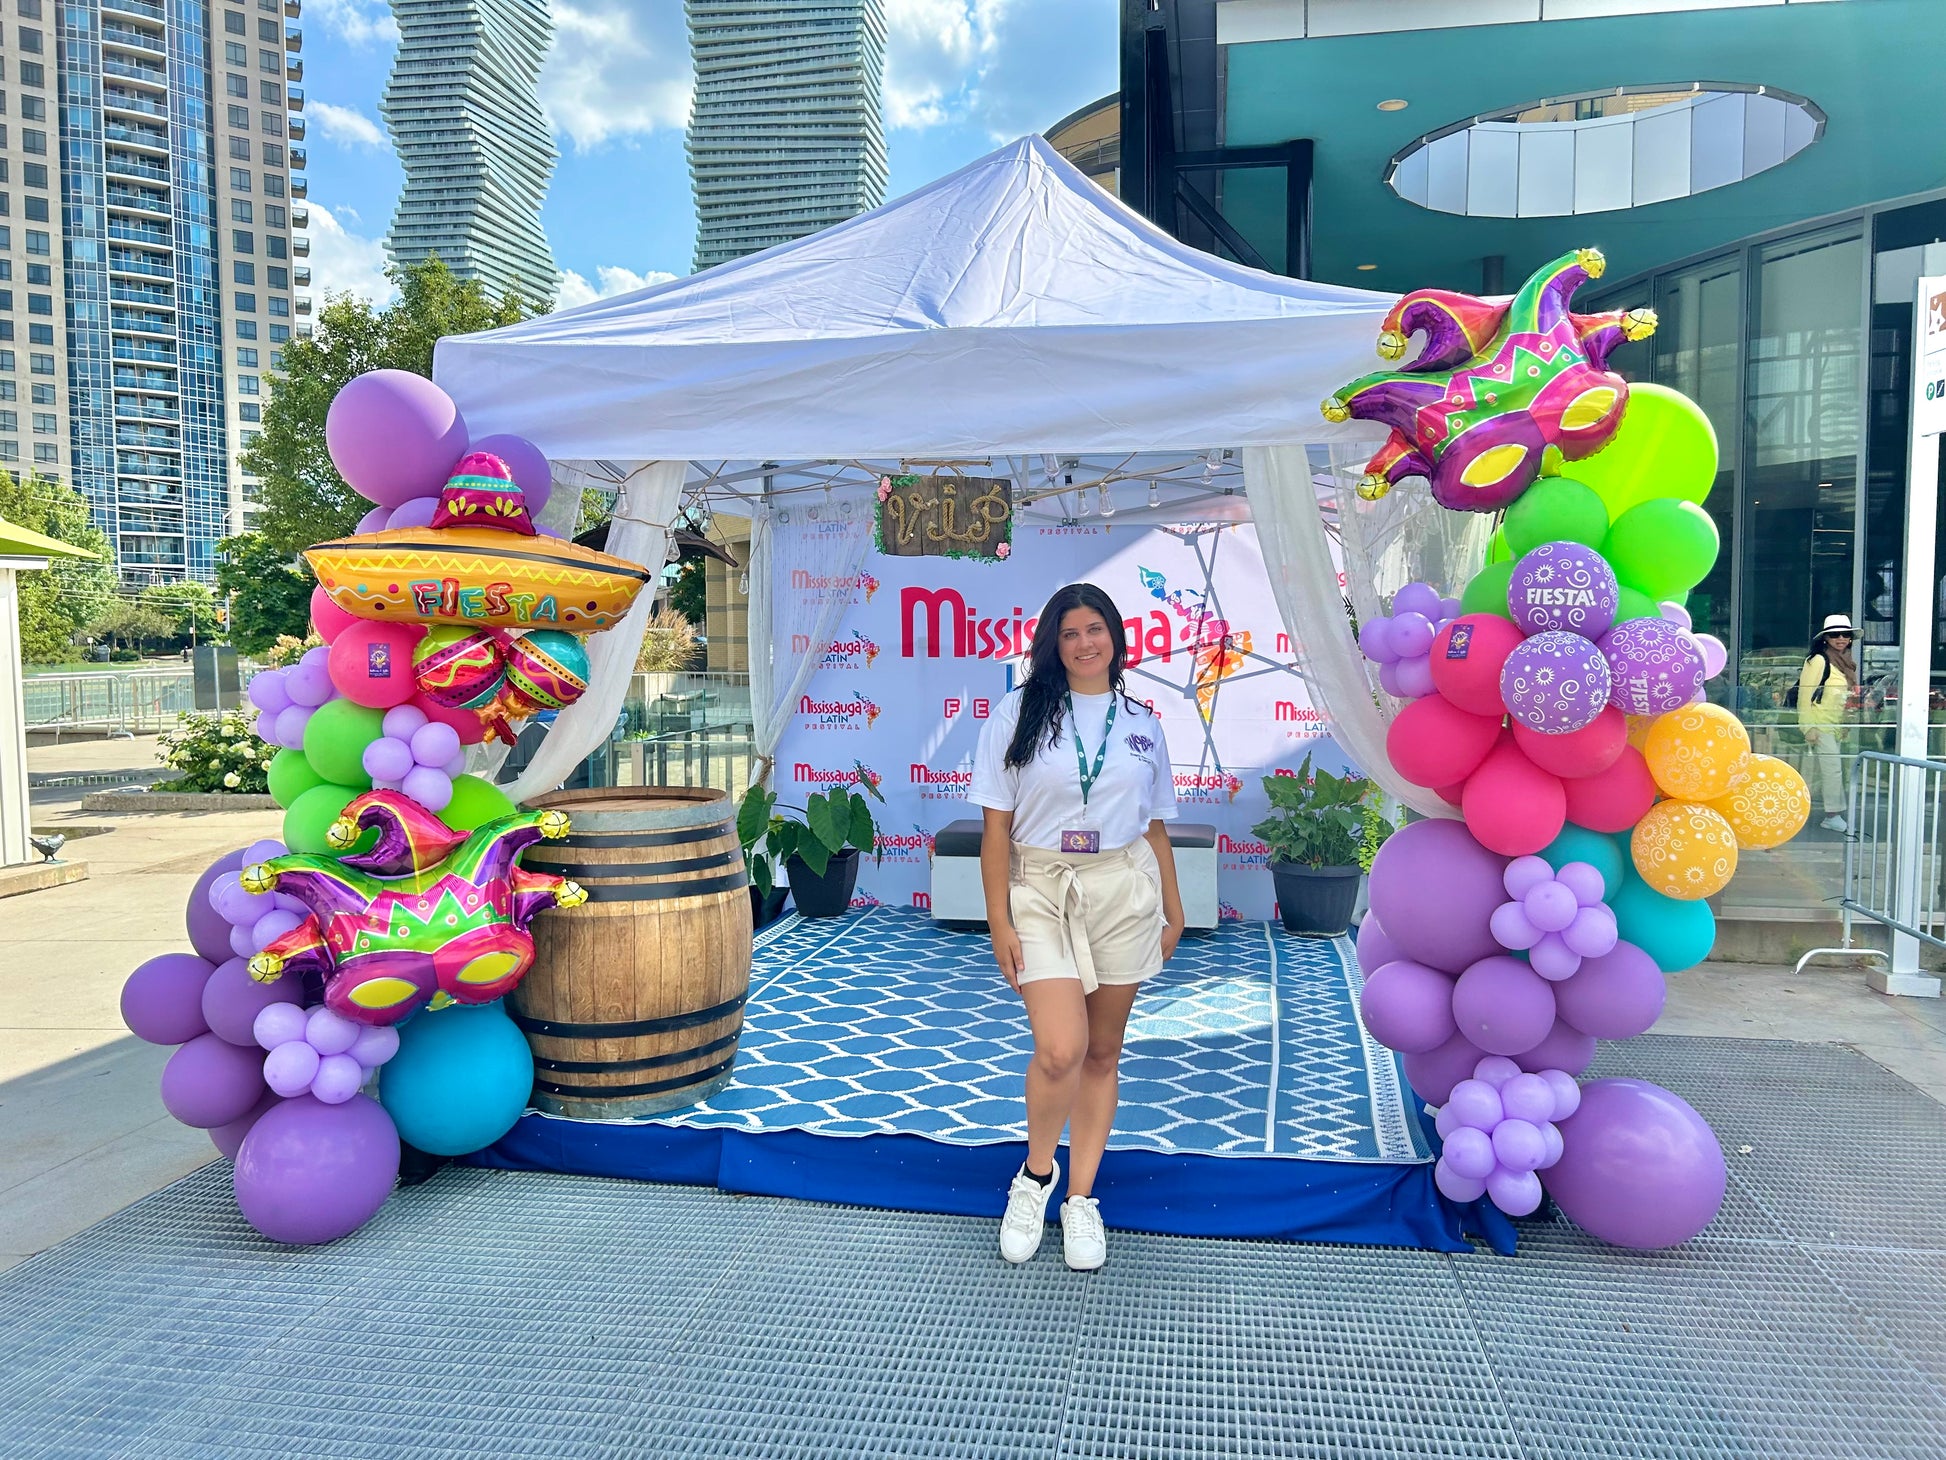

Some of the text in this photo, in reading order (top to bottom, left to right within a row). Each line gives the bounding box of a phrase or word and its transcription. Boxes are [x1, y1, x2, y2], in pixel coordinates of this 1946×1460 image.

[408, 577, 557, 622] FIESTA
[1526, 588, 1597, 607] FIESTA!
[820, 715, 849, 724] LATIN
[910, 764, 973, 786] Mississaug
[937, 784, 966, 793] LATIN
[1177, 788, 1208, 796] LATIN
